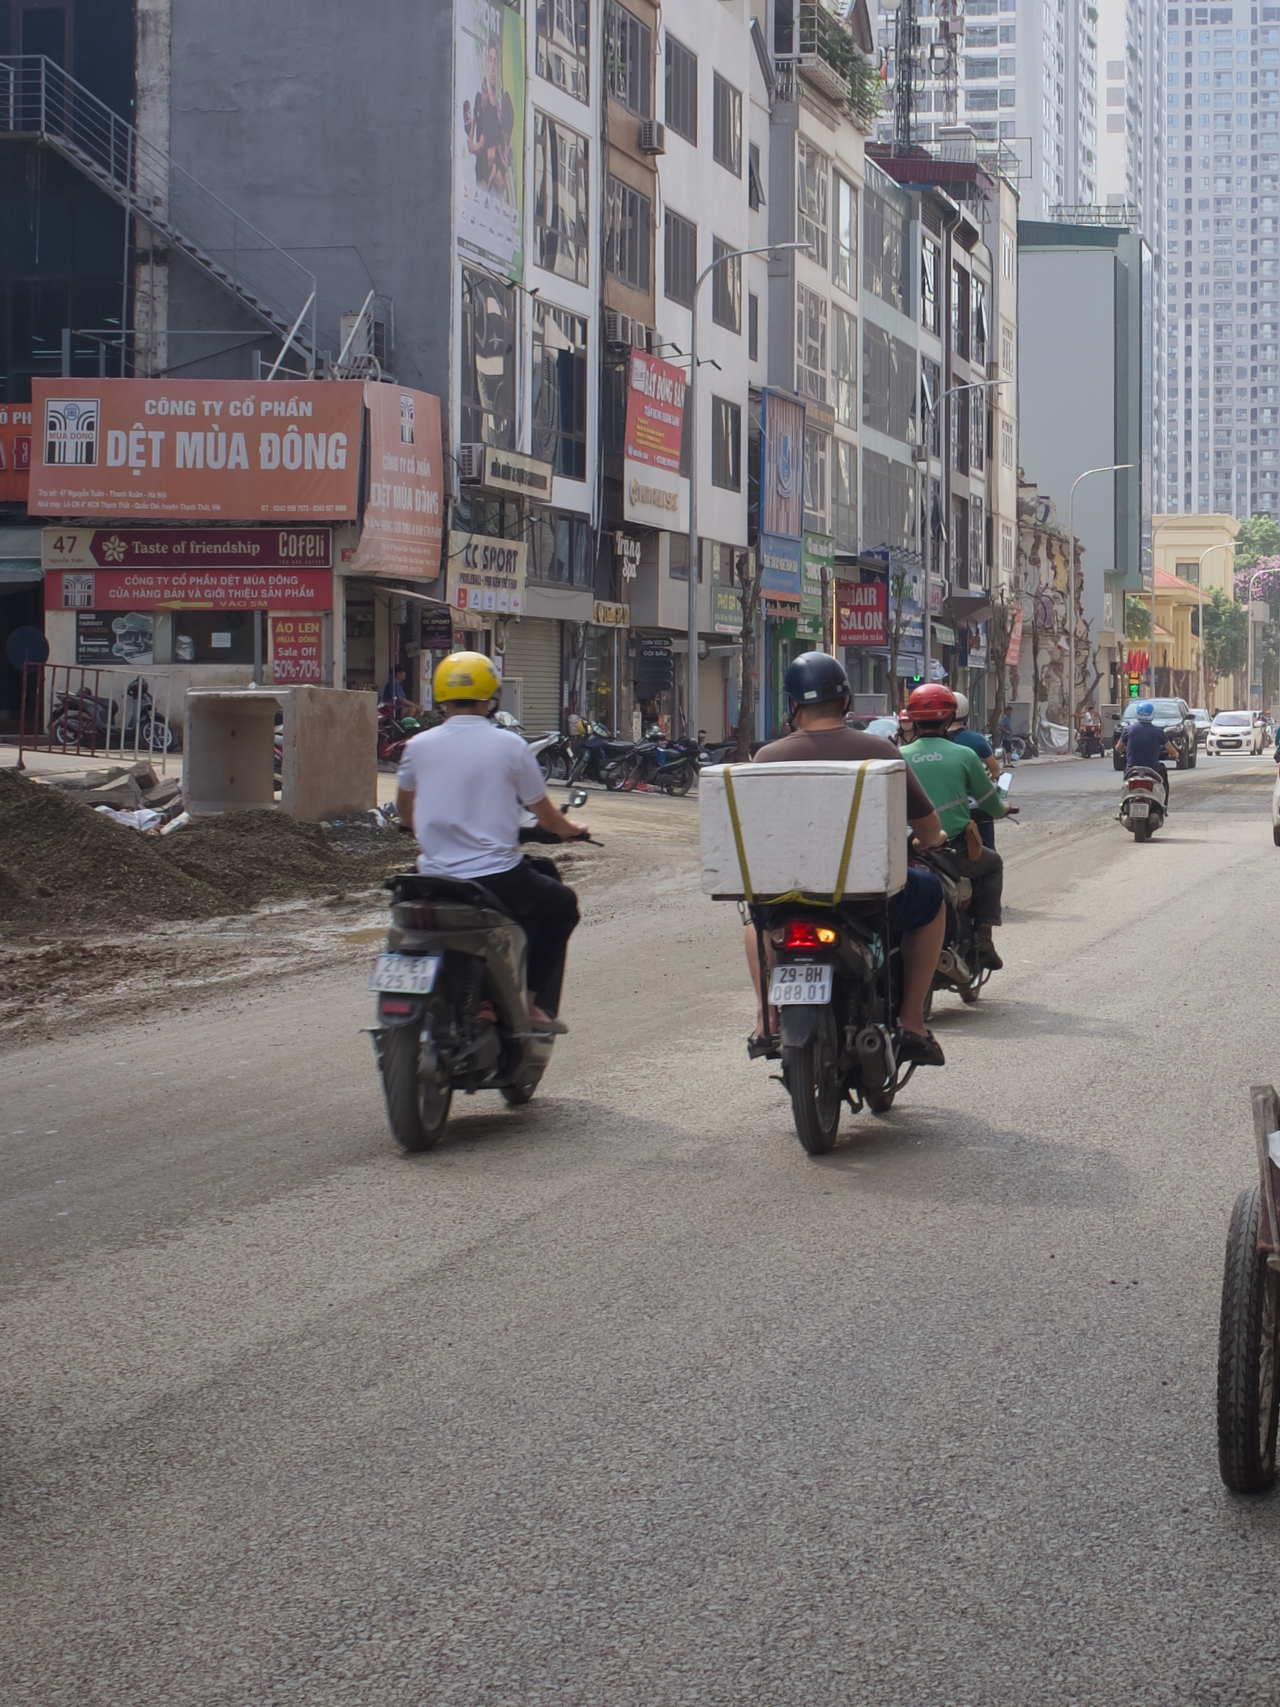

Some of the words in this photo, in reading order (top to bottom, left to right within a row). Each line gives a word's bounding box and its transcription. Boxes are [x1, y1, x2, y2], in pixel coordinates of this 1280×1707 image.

[145, 397, 196, 416] CÔNG
[202, 401, 223, 416] TY
[229, 395, 255, 417] CỔ
[260, 396, 312, 417] PHẦN
[106, 422, 165, 476] DỆT
[175, 424, 249, 470] MÙA
[259, 424, 347, 470] ĐÔNG
[393, 480, 413, 512] MÙA
[53, 536, 77, 553] 47
[132, 541, 169, 554] Taste
[172, 541, 187, 554] of
[190, 541, 261, 556] friendship
[278, 531, 325, 557] Cofeli
[616, 531, 641, 565] Trang
[464, 543, 479, 569] CC
[481, 545, 518, 574] SPORT
[622, 557, 637, 582] Spa
[125, 574, 153, 586] CÔNG
[156, 577, 169, 585] TY
[172, 572, 187, 586] CỔ
[189, 573, 217, 586] PHẦN
[220, 574, 240, 586] DỆT
[243, 574, 266, 586] MÙA
[268, 574, 298, 586] ĐÔNG
[109, 586, 130, 598] CỬA
[132, 588, 160, 598] HÀNG
[164, 588, 185, 598] BÁN
[188, 588, 201, 598] VÀ
[204, 587, 225, 598] GIỚI
[228, 587, 258, 600] THIỆU
[261, 586, 282, 598] SẢN
[285, 584, 315, 598] PHẨM
[219, 599, 247, 607] VÀO
[275, 620, 294, 634] ÁO
[298, 622, 320, 634] LEN
[840, 612, 883, 630] SALON
[278, 647, 298, 657] Sale
[301, 647, 317, 656] Off
[912, 751, 943, 763] Grab
[779, 966, 823, 984] 29-BH
[773, 983, 827, 1002] 088.01
